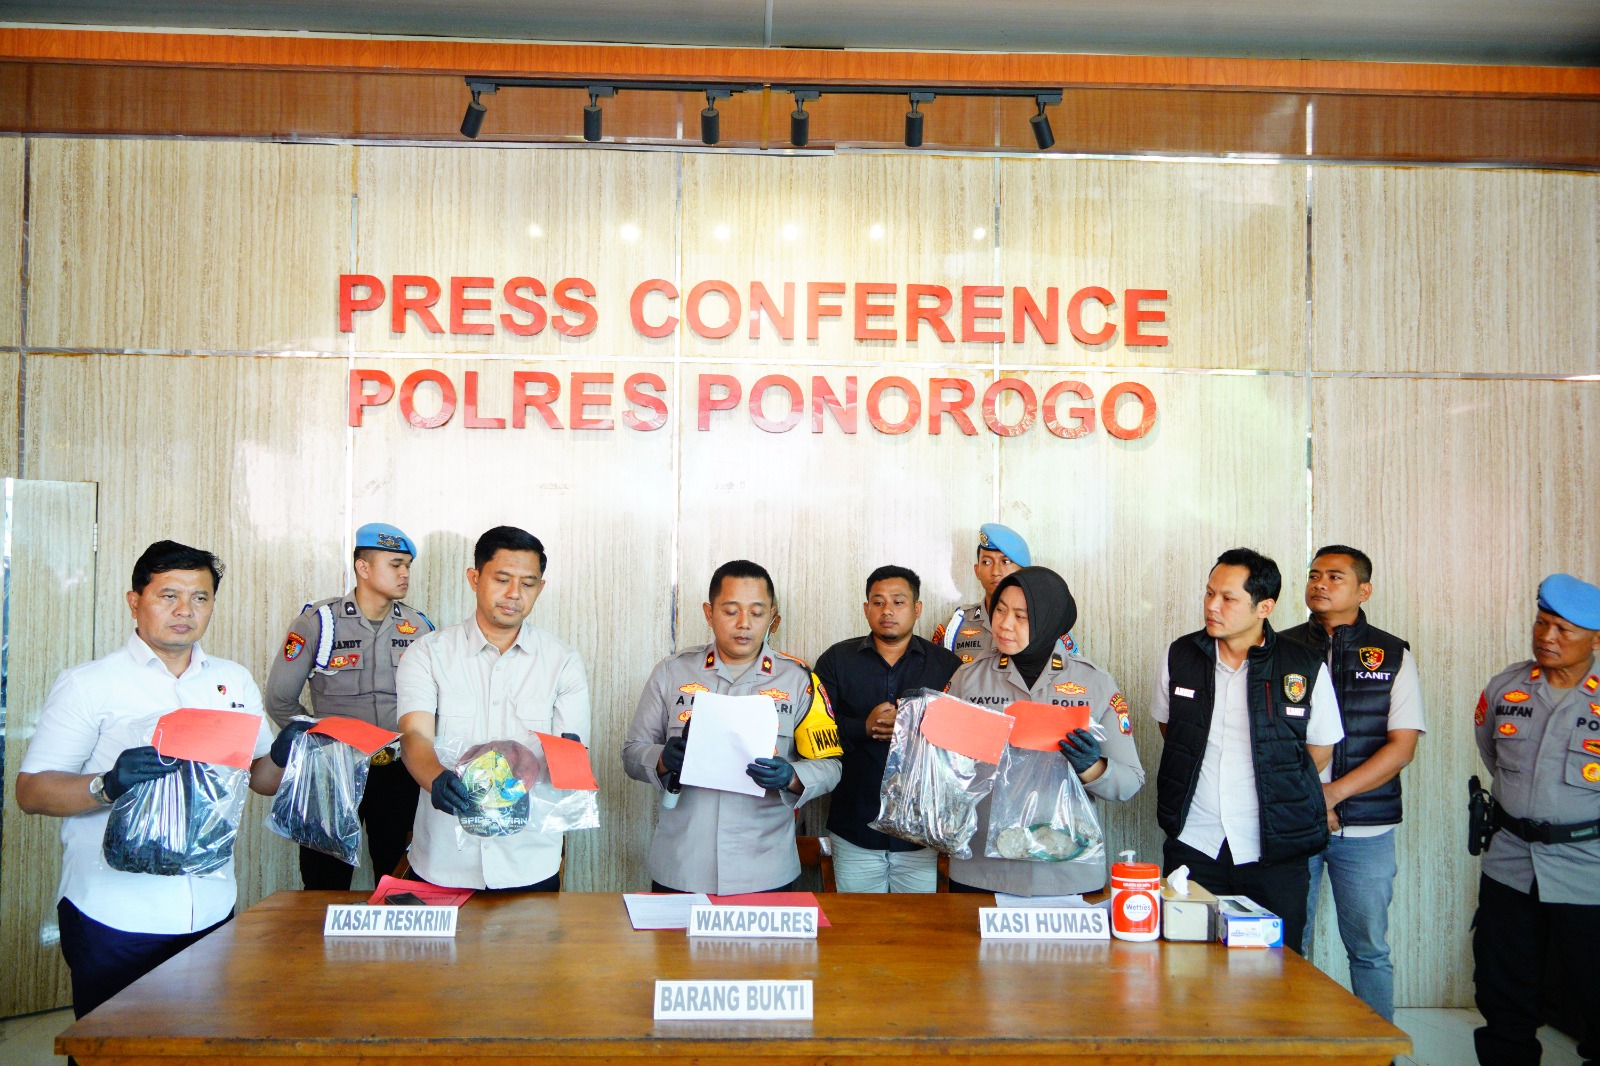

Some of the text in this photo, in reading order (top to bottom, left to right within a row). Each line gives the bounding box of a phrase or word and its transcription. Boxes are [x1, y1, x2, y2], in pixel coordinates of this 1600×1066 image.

[339, 274, 1170, 347] PRESS CONFERENCE
[348, 369, 1158, 440] POLRES PONOROGO
[956, 640, 982, 649] DANIEL
[1355, 671, 1391, 681] KANIT
[331, 909, 452, 932] KASAT RESKRIM
[696, 910, 813, 932] WAKAPOLRES
[985, 912, 1103, 934] KASI HUMAS
[660, 985, 805, 1012] BARANG BUKTI
